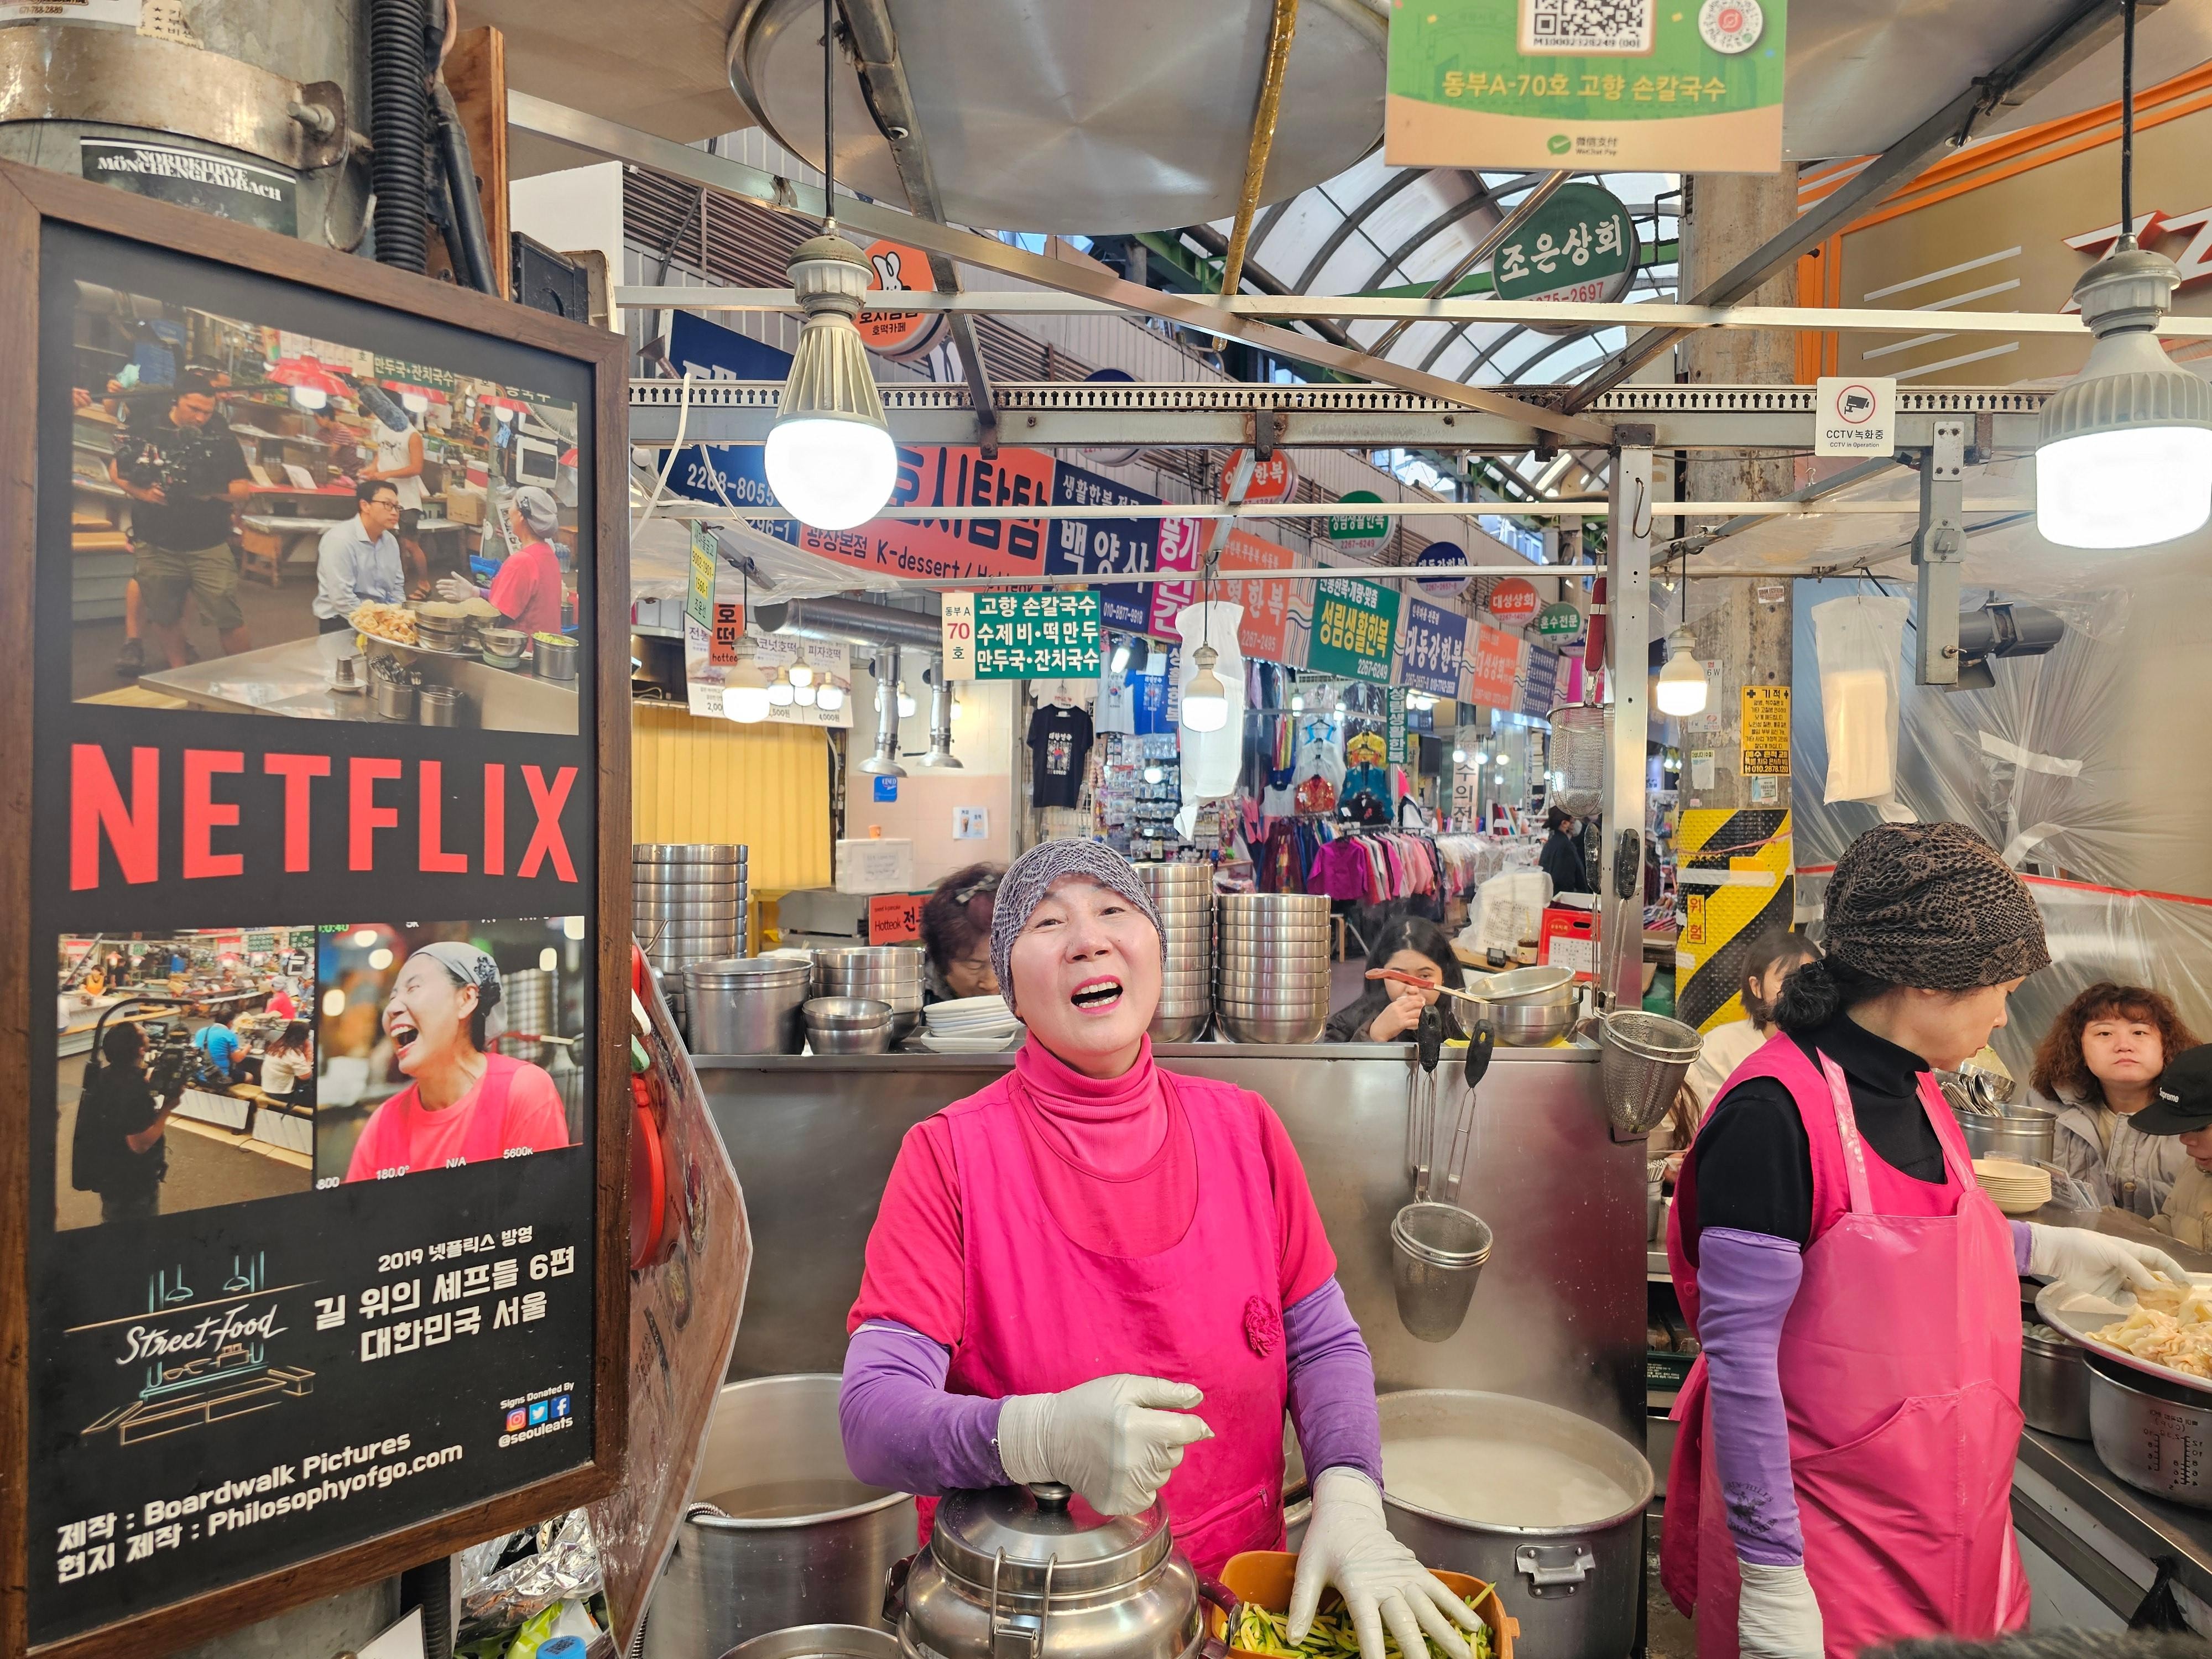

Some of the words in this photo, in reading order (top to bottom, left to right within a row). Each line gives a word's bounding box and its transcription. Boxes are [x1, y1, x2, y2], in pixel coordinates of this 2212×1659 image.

[1442, 72, 1569, 98] 동부A-70호
[1577, 74, 1624, 101] 고향
[1631, 75, 1727, 102] 손칼국수
[97, 155, 282, 202] MÖNCHENGLADBACH
[134, 150, 248, 181] NORDKURVE
[1500, 214, 1622, 283] 조은상회
[872, 322, 906, 335] 호떡카페
[1826, 430, 1854, 439] CCTV
[1855, 429, 1884, 440] 녹화중
[877, 539, 961, 577] K-dessert
[1060, 519, 1150, 594] 백양사
[1340, 539, 1375, 550] 2267-6249
[945, 607, 962, 616] 동부
[963, 607, 971, 616] A
[979, 596, 1018, 617] 고향
[1022, 596, 1097, 617] 손칼국수
[1493, 592, 1534, 609] 대성상회
[947, 622, 970, 640] 70
[1319, 599, 1390, 659] 성림생활한복
[1540, 614, 1578, 629] 혼수전문
[712, 653, 738, 662] hotteo
[758, 638, 797, 655] 코넛호떡
[808, 645, 842, 660] 피자호떡
[952, 646, 965, 660] 호
[1405, 625, 1463, 677] 대동강한복
[1357, 658, 1388, 681] 2267-6249
[707, 702, 723, 712] 2,00
[769, 708, 791, 718] ,500원
[70, 743, 579, 891] NETFLIX
[874, 917, 902, 932] Hotteok
[1689, 897, 1702, 941] 위험
[446, 1157, 467, 1169] N/A
[378, 1248, 424, 1273] 2019
[429, 1233, 495, 1261] 넷플릭스
[501, 1225, 533, 1247] 방영
[315, 1295, 346, 1331] 길
[358, 1278, 421, 1319] 위의
[432, 1258, 519, 1305] 셰프들
[529, 1245, 575, 1281] 6편
[116, 1316, 221, 1365] Street
[360, 1305, 482, 1363] 대한민국
[493, 1291, 547, 1330] 서울
[499, 1396, 526, 1410] Signs
[526, 1384, 562, 1402] Donated
[563, 1382, 575, 1391] By
[498, 1416, 574, 1448] @seouleats
[56, 1512, 118, 1552] 제작
[144, 1462, 295, 1525] Boardwalk
[302, 1432, 411, 1479] Pictures
[56, 1546, 116, 1584] 현지
[126, 1524, 182, 1563] 제작
[208, 1442, 463, 1539] Philosophyofgo.com
